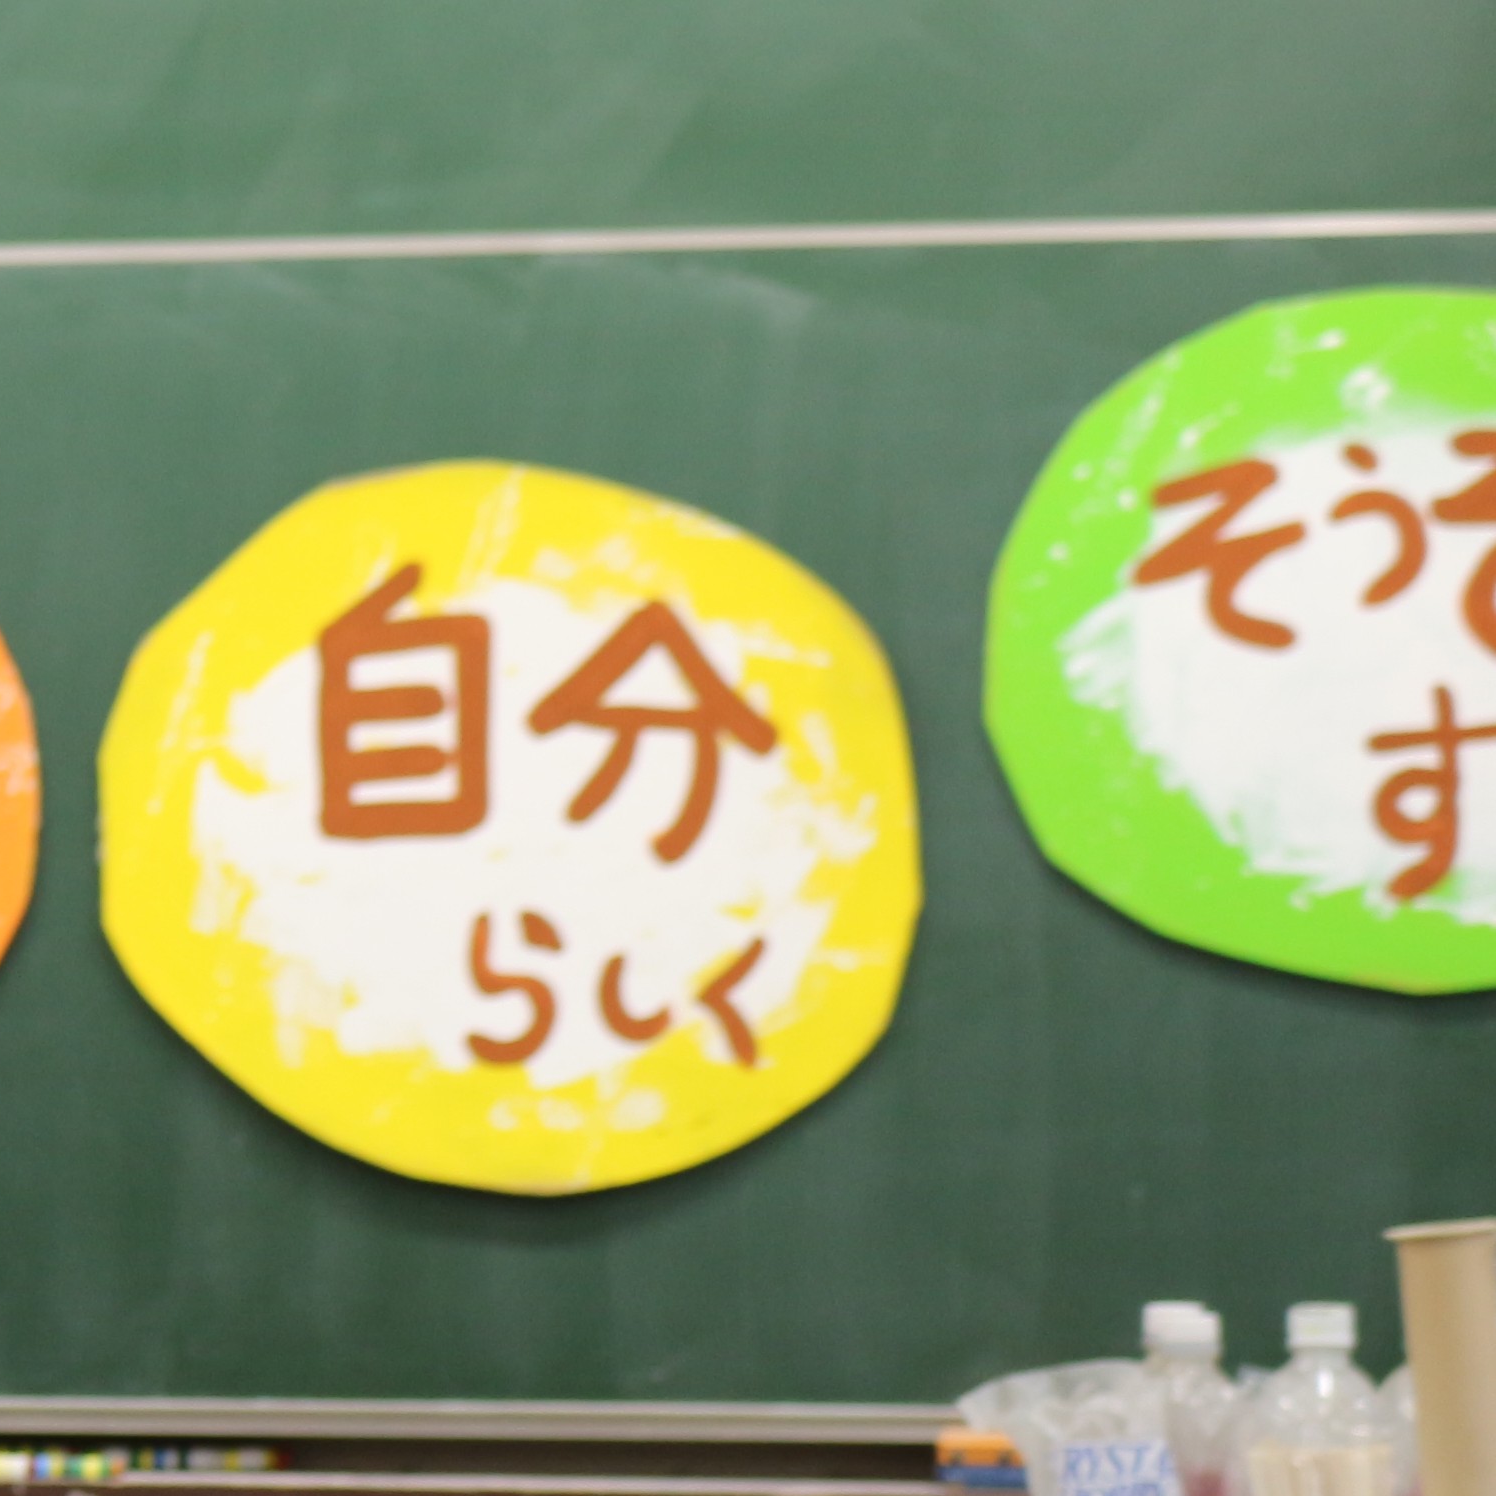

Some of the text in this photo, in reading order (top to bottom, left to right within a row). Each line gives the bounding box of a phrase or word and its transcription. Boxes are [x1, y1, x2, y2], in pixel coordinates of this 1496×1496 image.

[318, 563, 777, 865] 自分
[466, 910, 766, 1070] らしく
